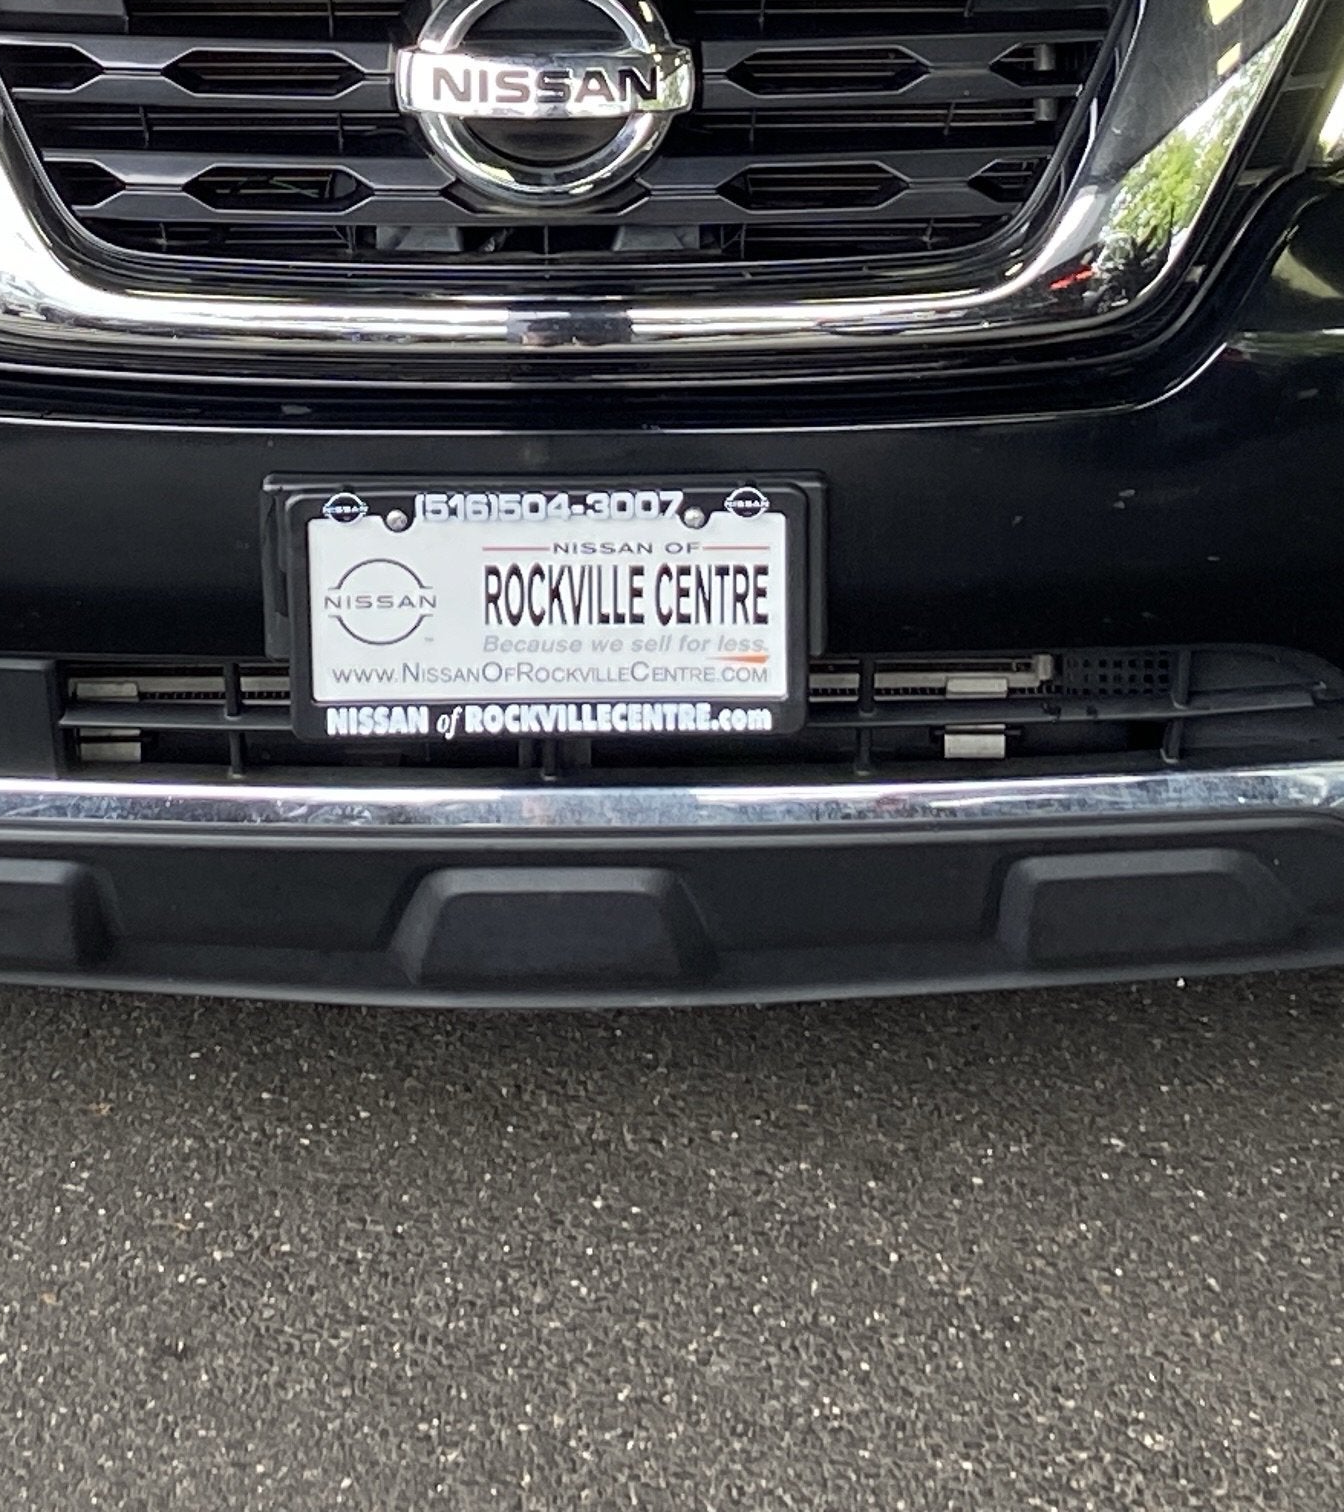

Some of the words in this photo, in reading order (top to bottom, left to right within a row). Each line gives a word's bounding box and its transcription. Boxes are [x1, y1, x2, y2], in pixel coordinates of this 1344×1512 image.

[432, 66, 659, 104] NISSAN
[553, 541, 653, 555] NISSAN
[664, 541, 700, 555] OF
[324, 594, 437, 610] NISSAN
[484, 562, 645, 627] ROCKVILLE
[656, 562, 769, 626] CENTRE
[482, 634, 583, 653] Because
[591, 638, 624, 653] we
[631, 634, 671, 653] sell
[678, 634, 711, 653] for
[717, 634, 769, 653] less.
[326, 705, 430, 736] NISSAN
[436, 705, 463, 740] of
[464, 702, 773, 733] ROCKVILLECENTRE.com
